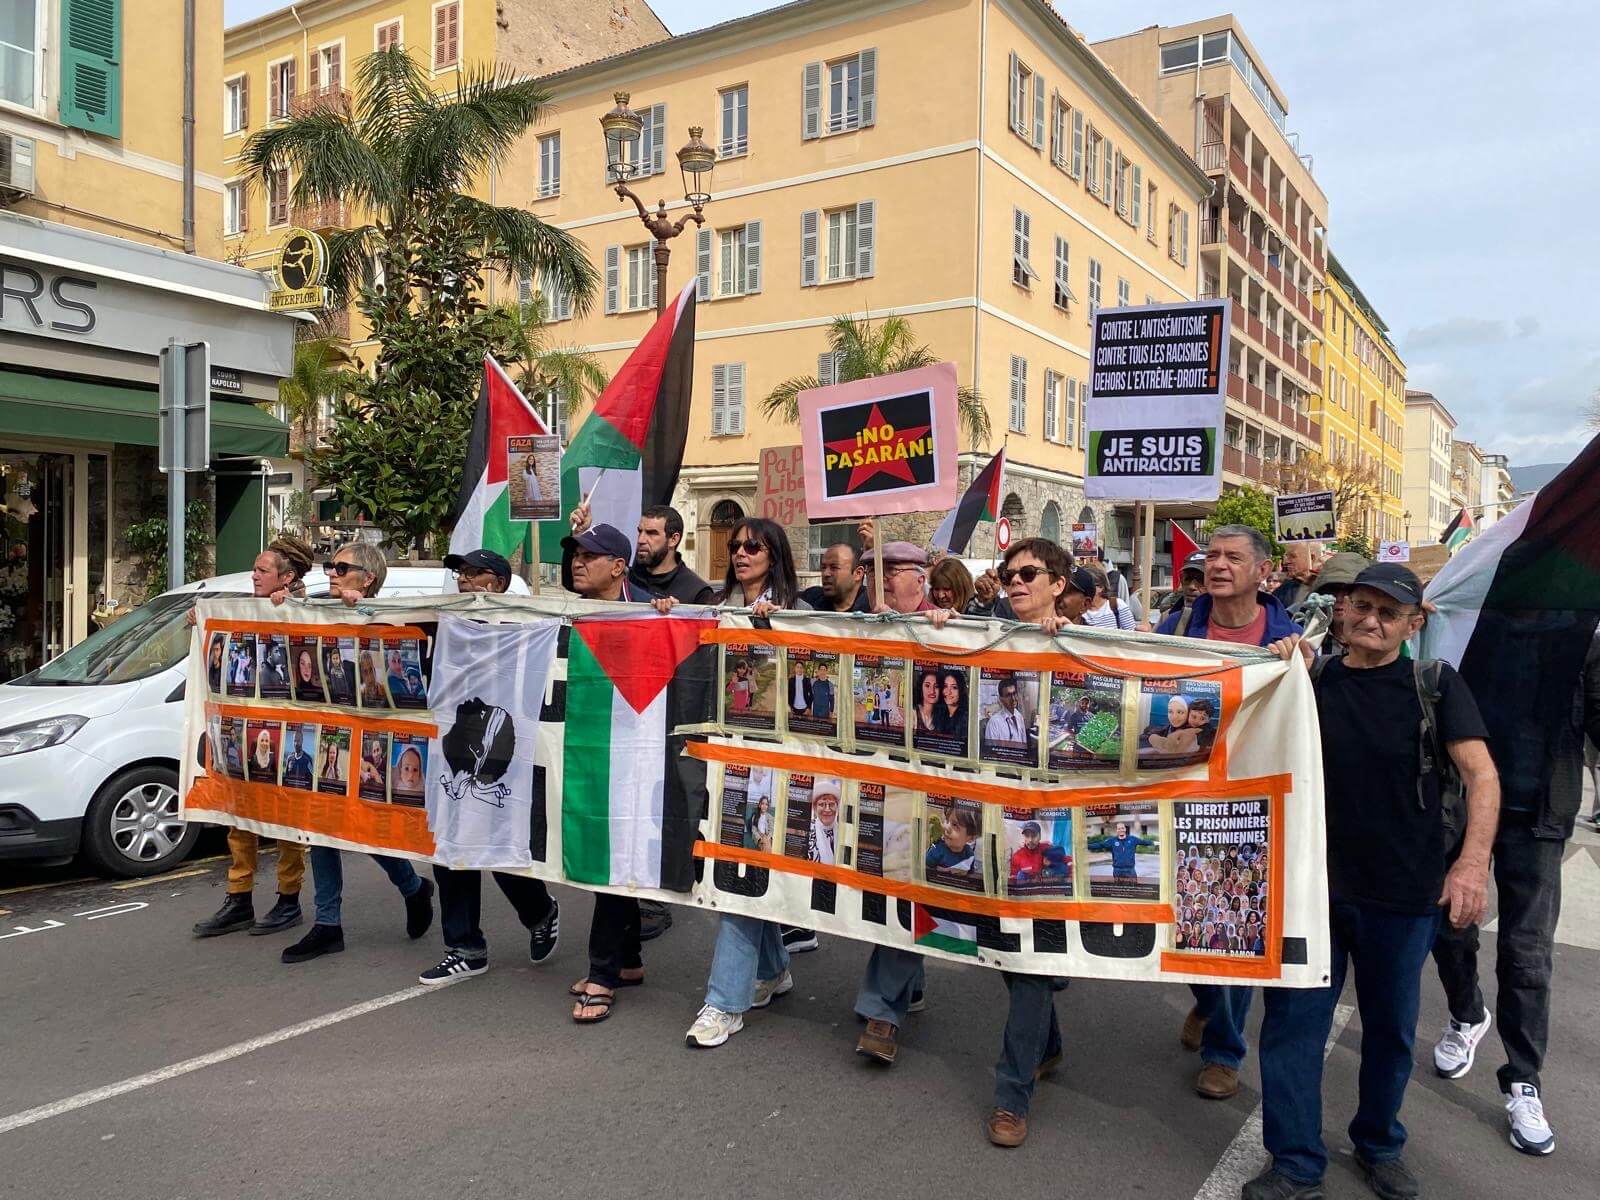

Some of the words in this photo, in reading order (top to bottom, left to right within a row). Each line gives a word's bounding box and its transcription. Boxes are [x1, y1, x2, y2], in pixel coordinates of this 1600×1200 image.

[272, 292, 320, 307] INTERFLORA
[1101, 320, 1132, 341] CONTRE
[1134, 314, 1207, 338] L'ANTISÉMITISME
[1097, 346, 1126, 366] CONTRE
[1128, 344, 1148, 364] TOUS
[1150, 344, 1164, 364] LES
[1166, 342, 1208, 362] RACISMES
[1094, 371, 1126, 391] DEHORS
[1127, 366, 1208, 390] L'EXTRÊME-DROITE
[826, 436, 934, 470] PASARÁN!
[1104, 437, 1133, 457] JE
[1141, 436, 1202, 456] SUIS
[1103, 456, 1200, 472] ANTIRACISTE
[1055, 671, 1085, 680] GAZA
[1144, 678, 1177, 688] GAZA
[860, 784, 883, 795] GAZA
[1185, 801, 1228, 815] LIBERTÉ
[1232, 801, 1260, 815] POUR
[1174, 817, 1192, 829] LES
[1195, 815, 1270, 830] PRISONNIÈRES
[1179, 831, 1265, 844] PALESTINIENNES
